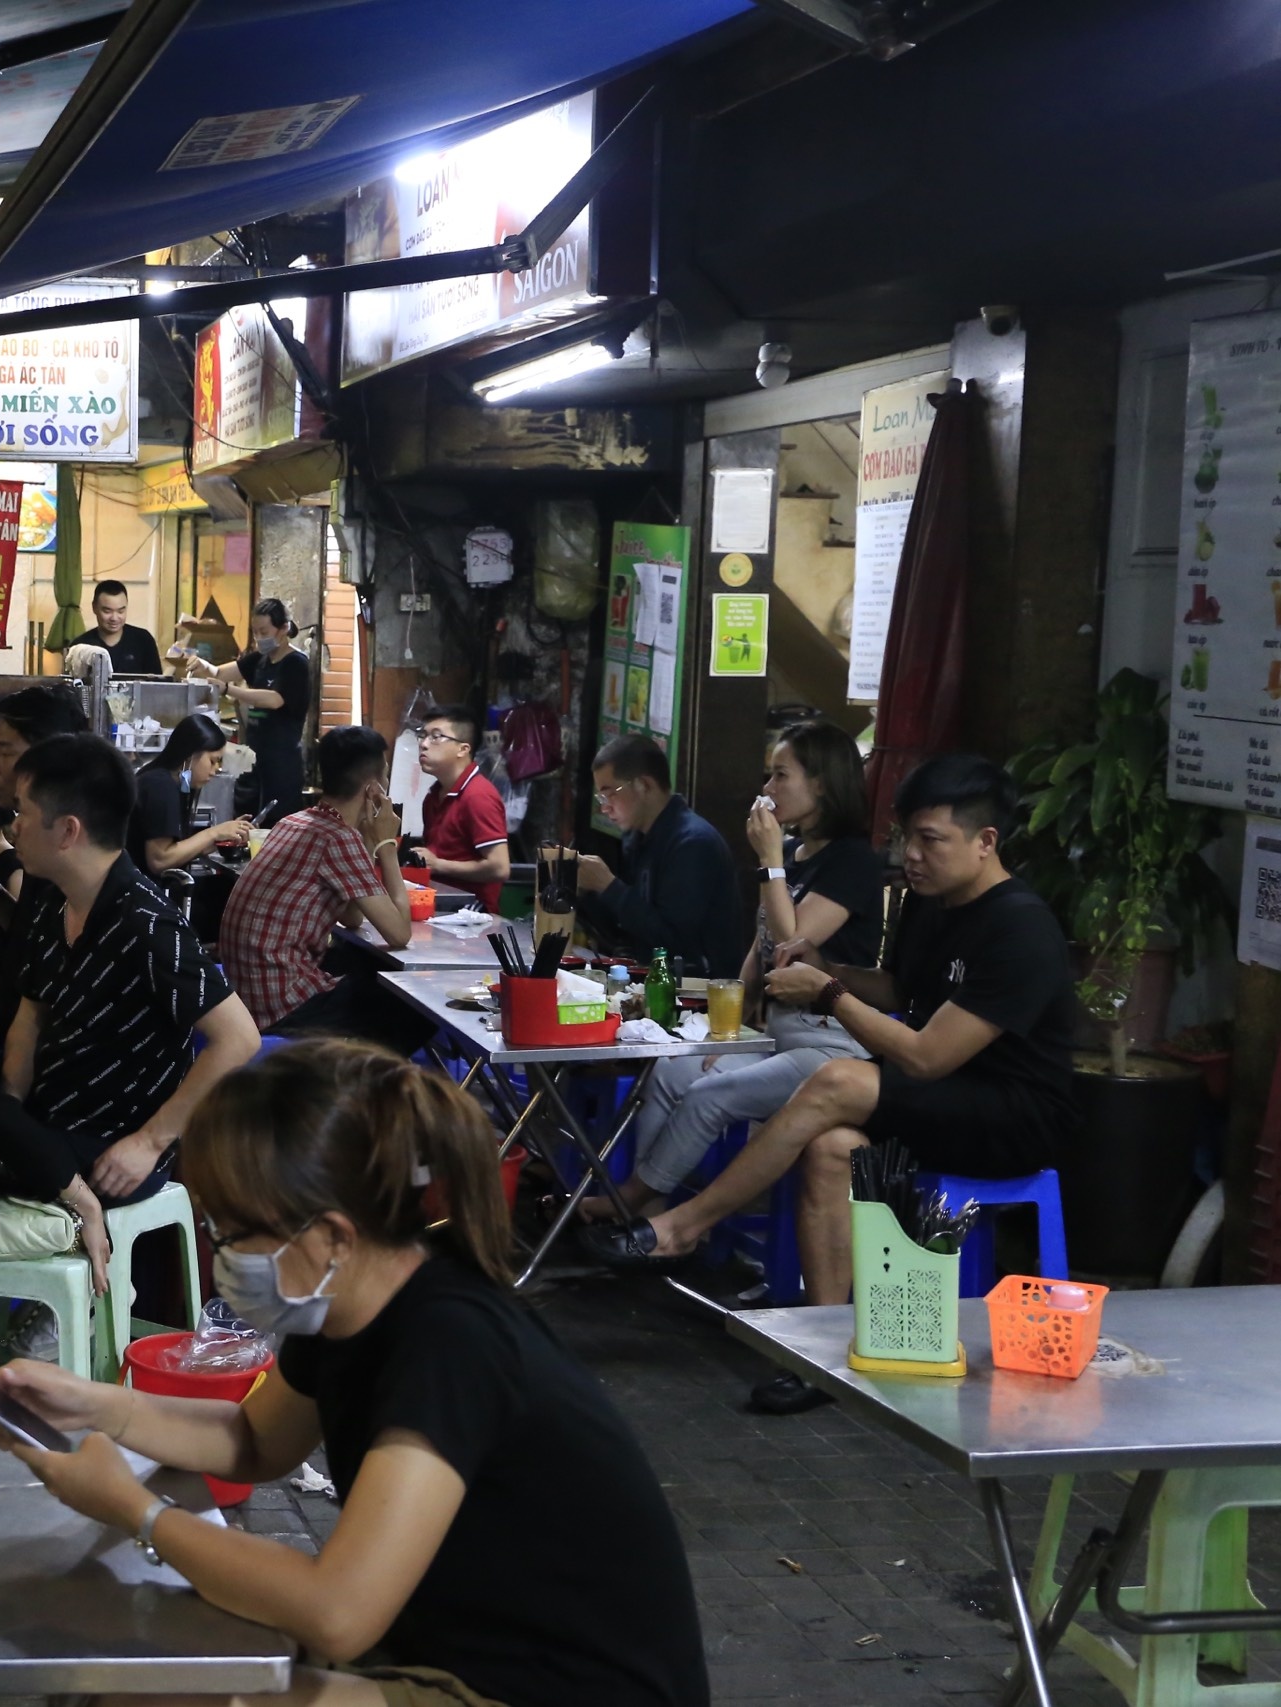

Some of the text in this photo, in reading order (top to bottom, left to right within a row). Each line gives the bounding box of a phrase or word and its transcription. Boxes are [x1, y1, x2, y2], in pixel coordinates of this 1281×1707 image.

[1, 387, 60, 414] MIẾN
[67, 391, 117, 415] XÀO
[23, 414, 99, 446] SỐNG
[872, 405, 909, 433] Loan
[863, 448, 883, 482] CƠM
